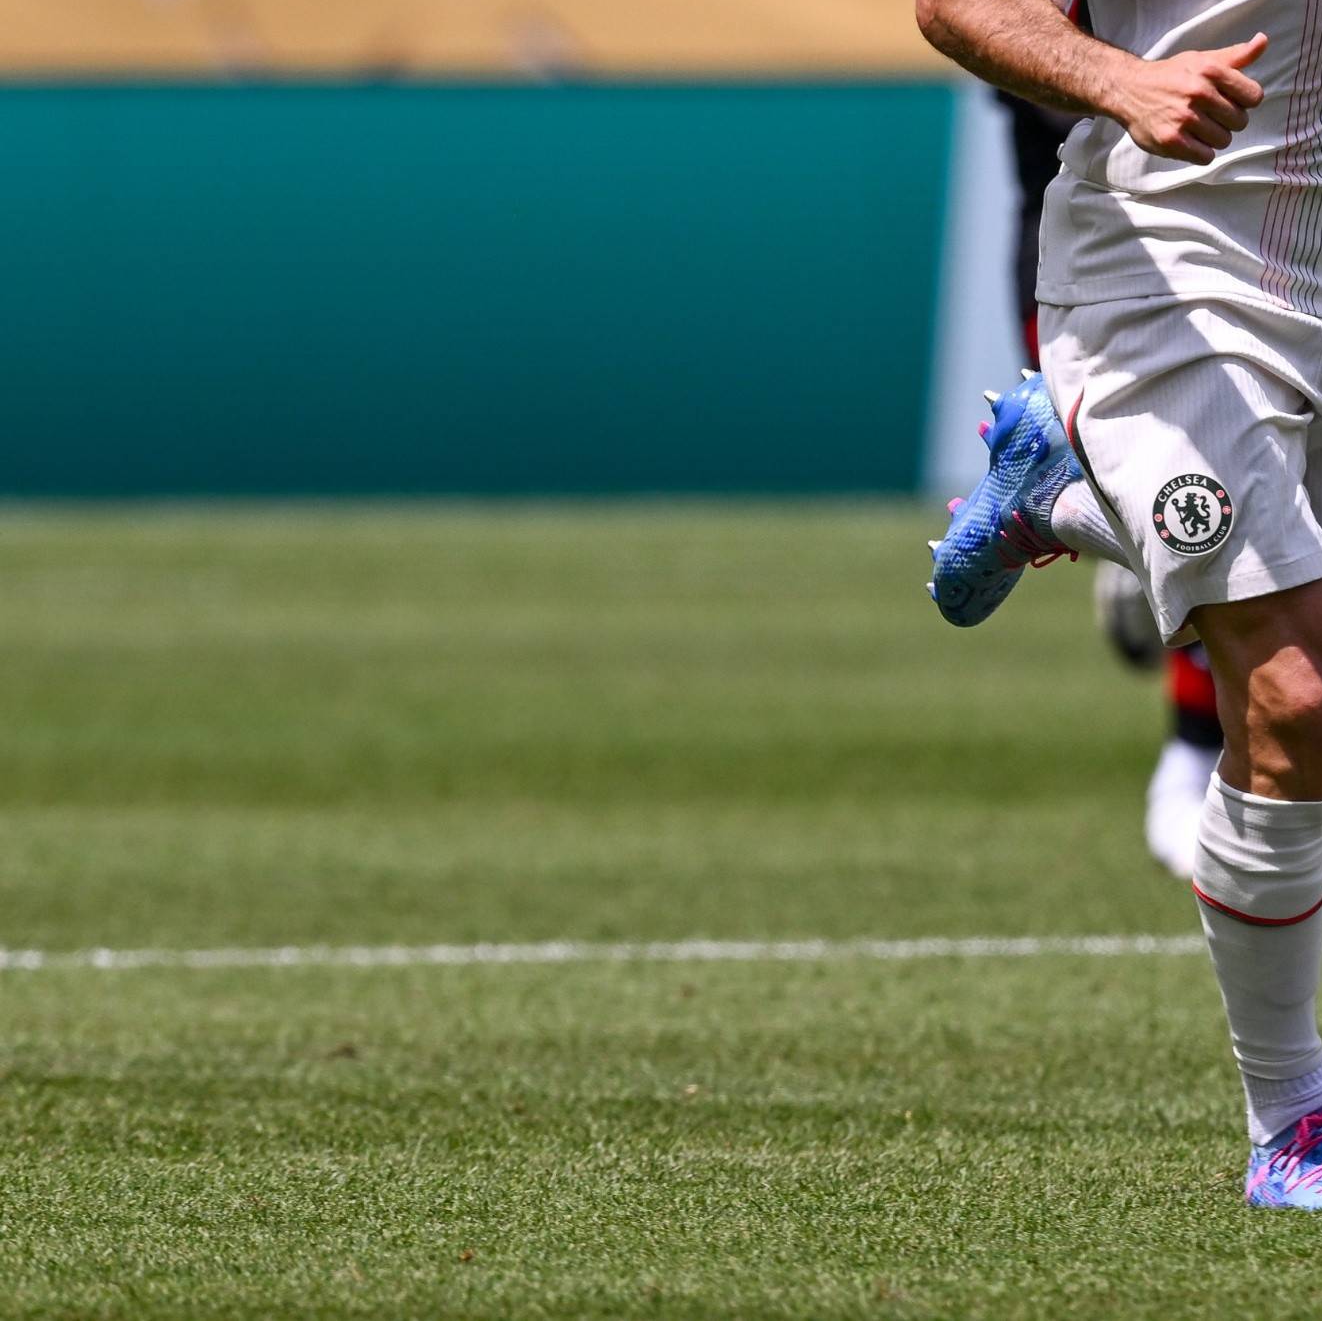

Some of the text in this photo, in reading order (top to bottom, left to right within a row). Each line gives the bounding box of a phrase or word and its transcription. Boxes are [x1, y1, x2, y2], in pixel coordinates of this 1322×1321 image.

[1158, 475, 1208, 502] CHELSEA
[1176, 525, 1227, 551] FOOTBALL CLUB
